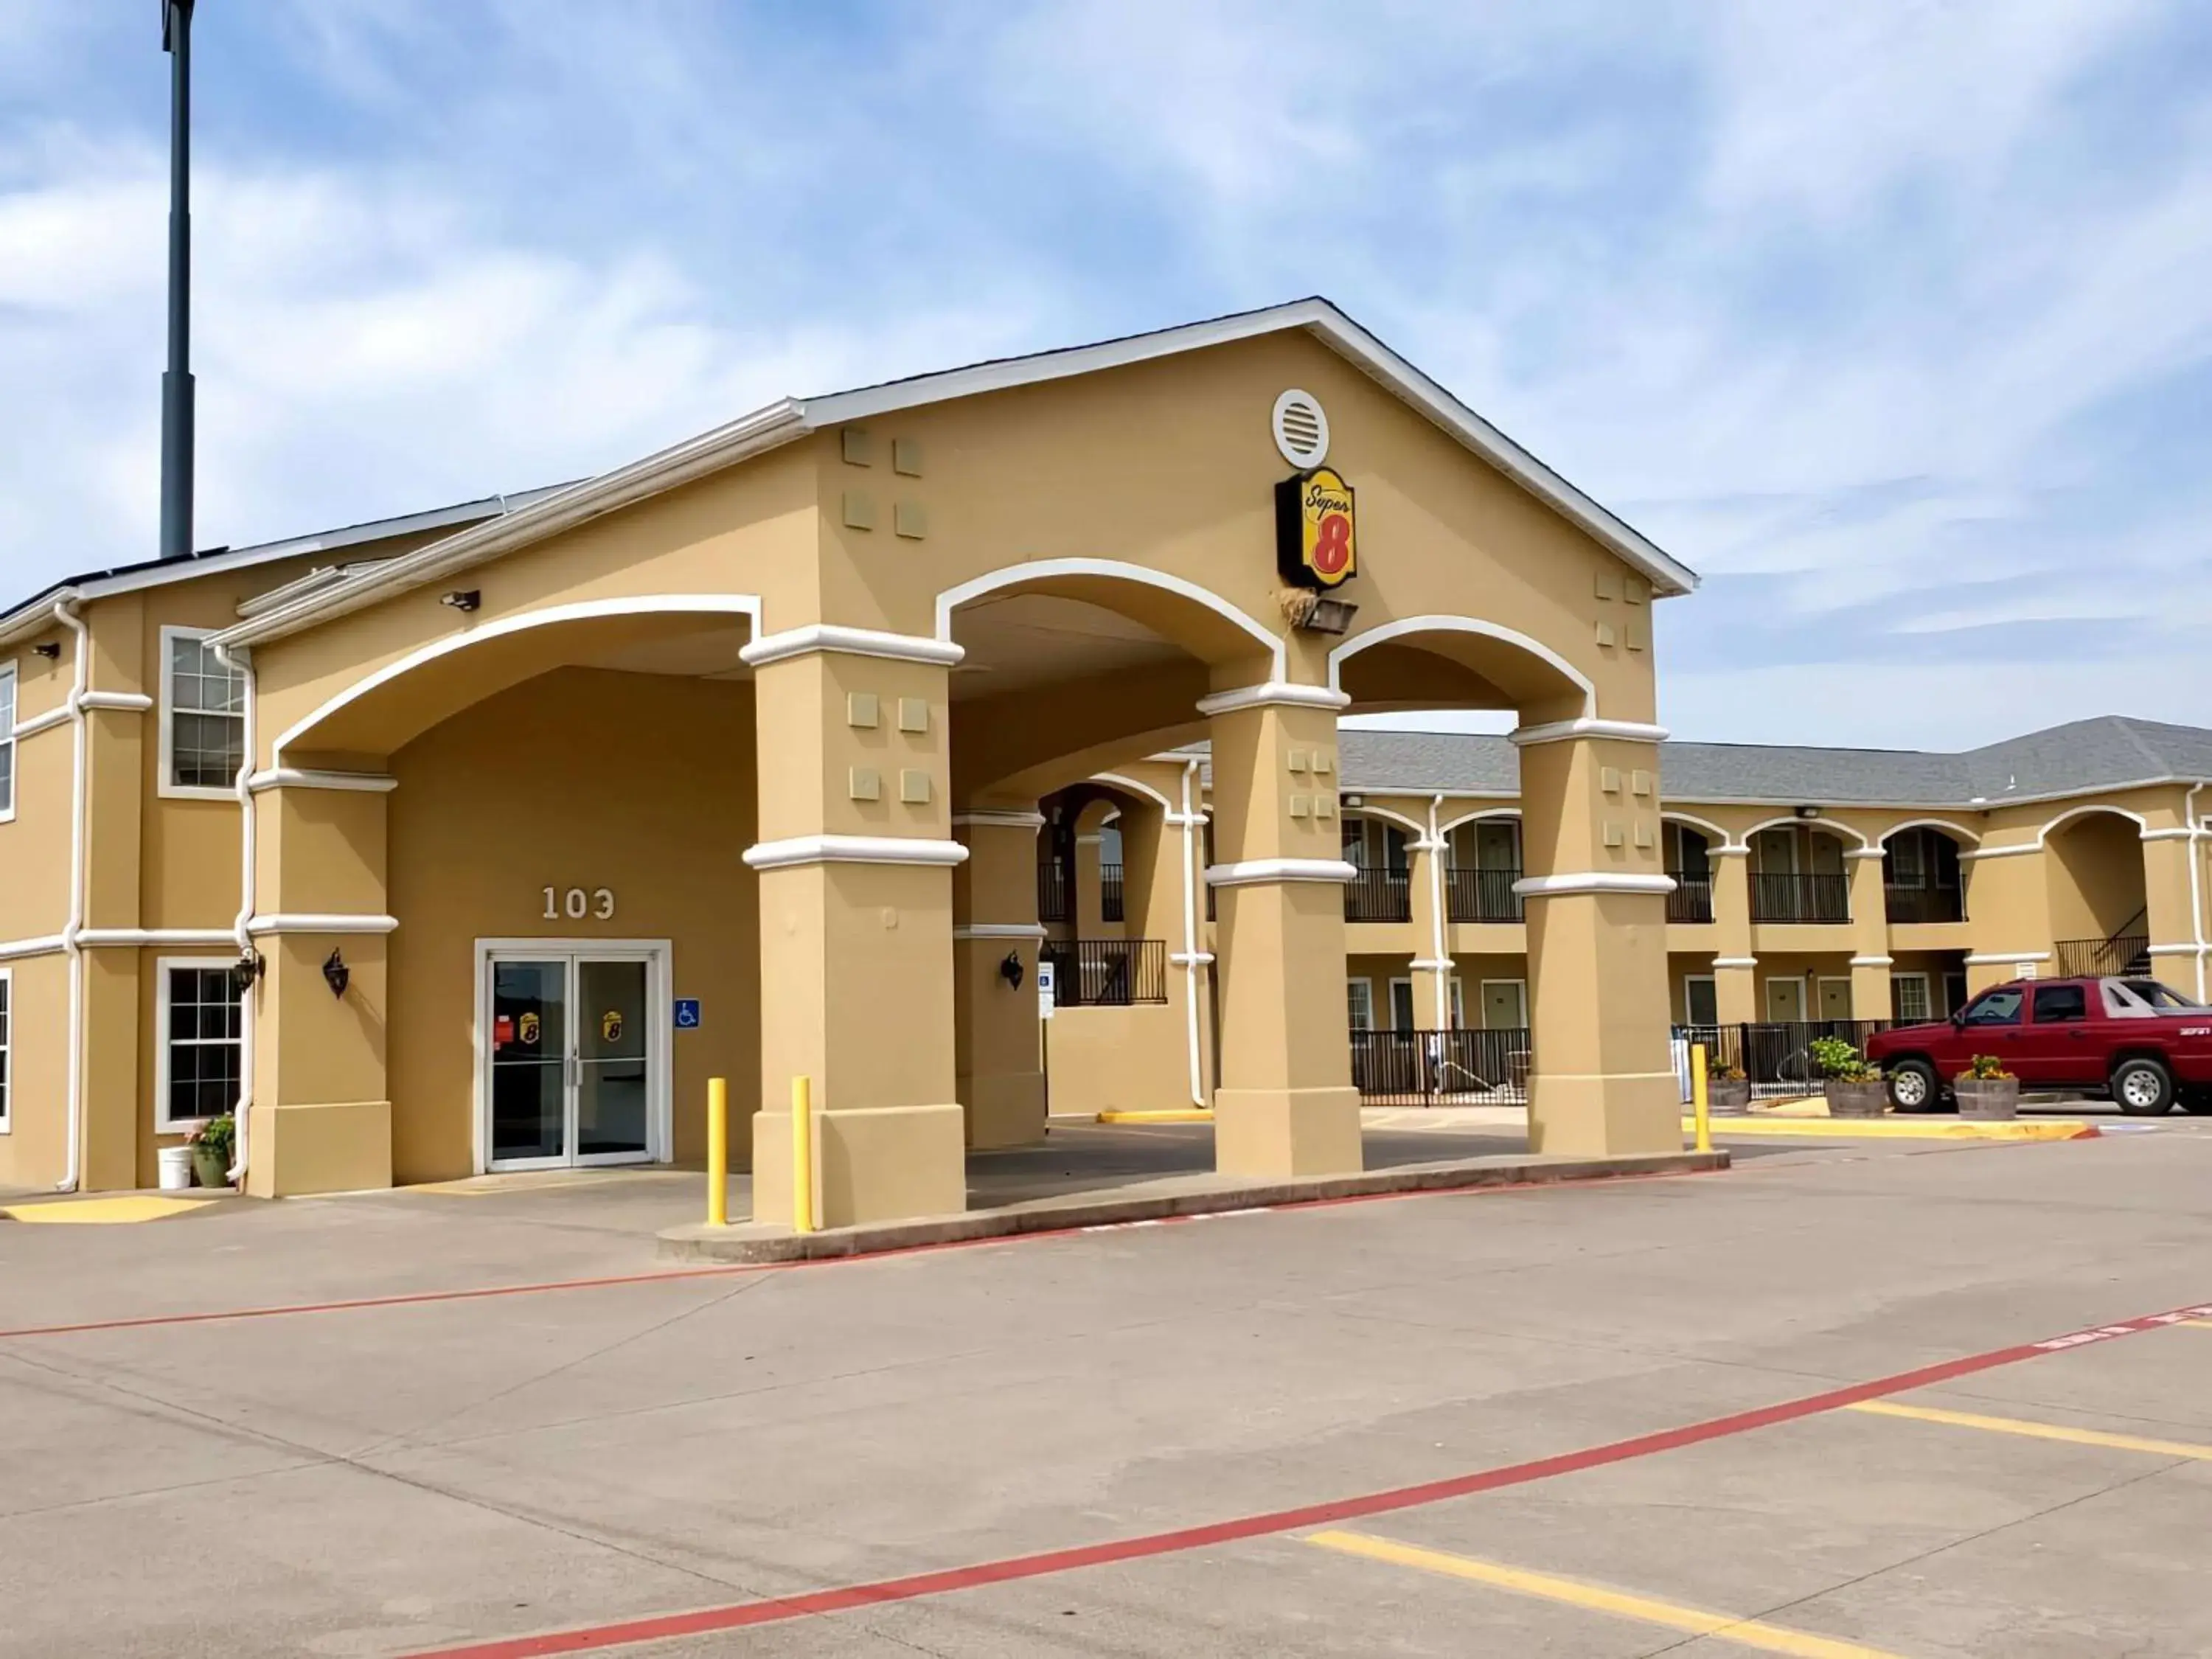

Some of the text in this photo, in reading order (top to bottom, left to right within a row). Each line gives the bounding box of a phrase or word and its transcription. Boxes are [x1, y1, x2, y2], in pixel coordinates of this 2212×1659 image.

[1306, 484, 1349, 521] Super
[1314, 515, 1349, 573] 8
[543, 887, 614, 919] 103
[524, 1023, 538, 1040] 8
[608, 1022, 620, 1039] 8
